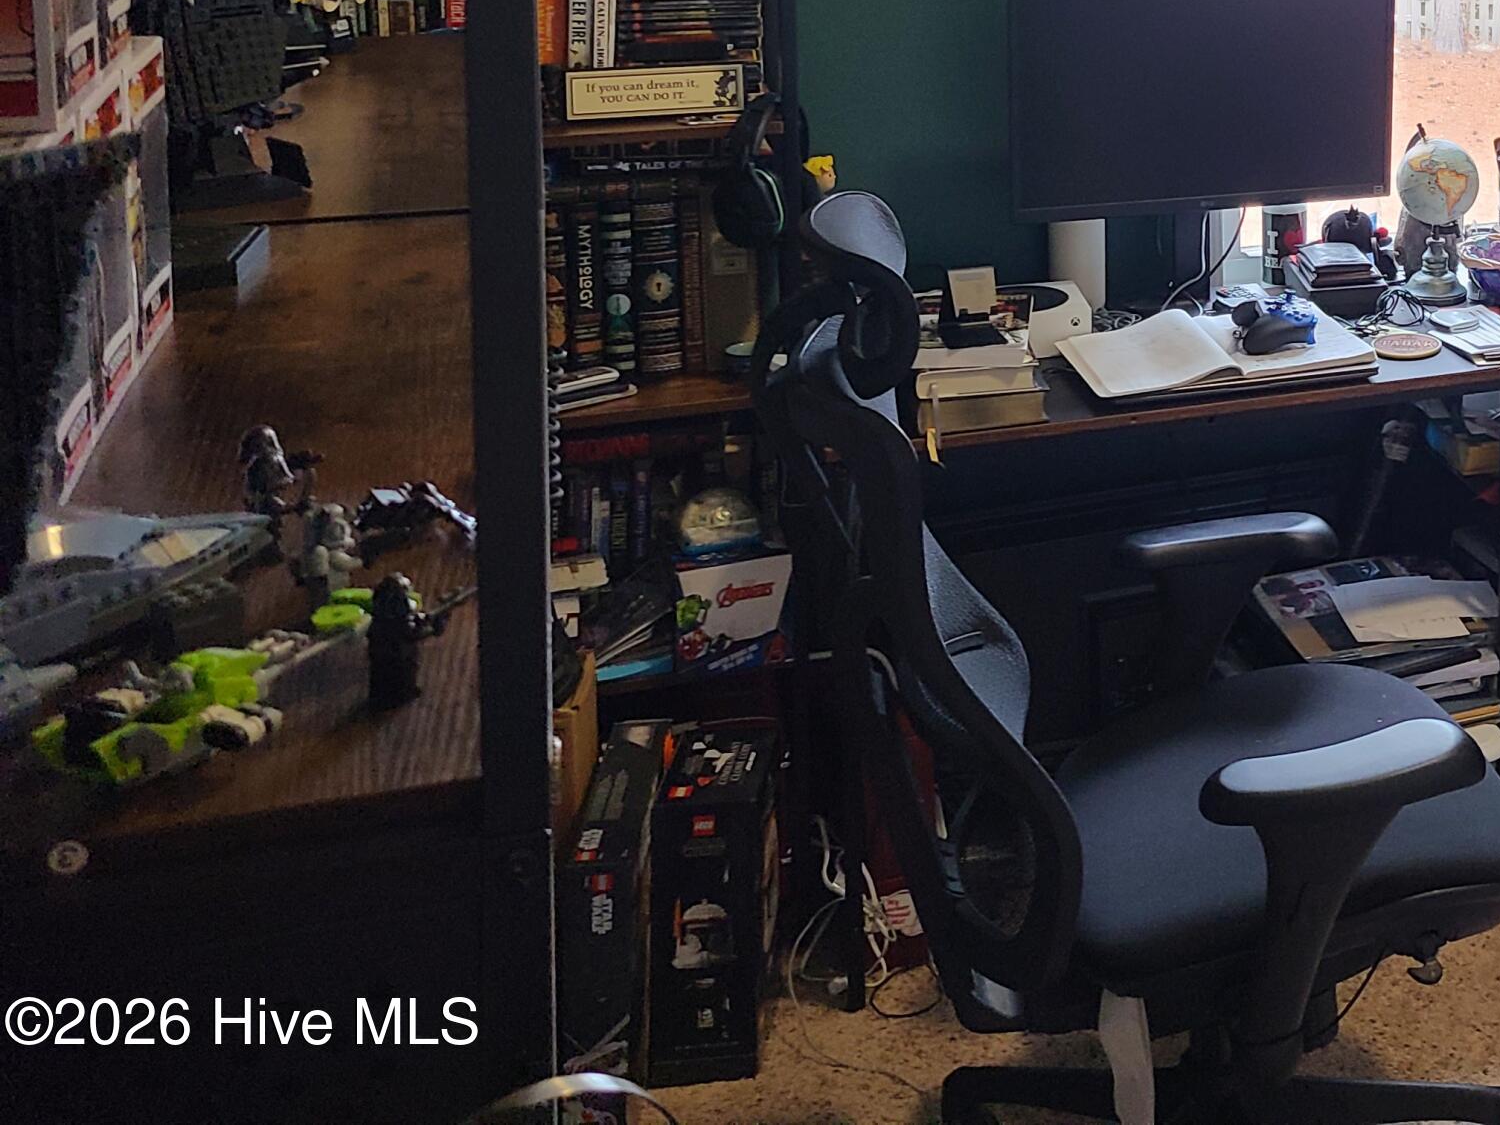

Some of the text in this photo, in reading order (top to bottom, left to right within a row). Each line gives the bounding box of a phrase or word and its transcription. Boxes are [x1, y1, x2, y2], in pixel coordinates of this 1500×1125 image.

[596, 1, 606, 37] CALVIN
[571, 20, 586, 45] FIRE
[596, 48, 605, 67] HOB
[586, 83, 596, 93] If
[599, 85, 620, 94] you
[623, 83, 644, 91] can
[646, 79, 683, 90] dream
[600, 95, 623, 104] YOU
[626, 93, 650, 102] CAN
[653, 92, 670, 101] DO
[633, 160, 666, 170] TALES
[1266, 230, 1279, 255] I
[577, 224, 594, 310] MYTHOLOGY
